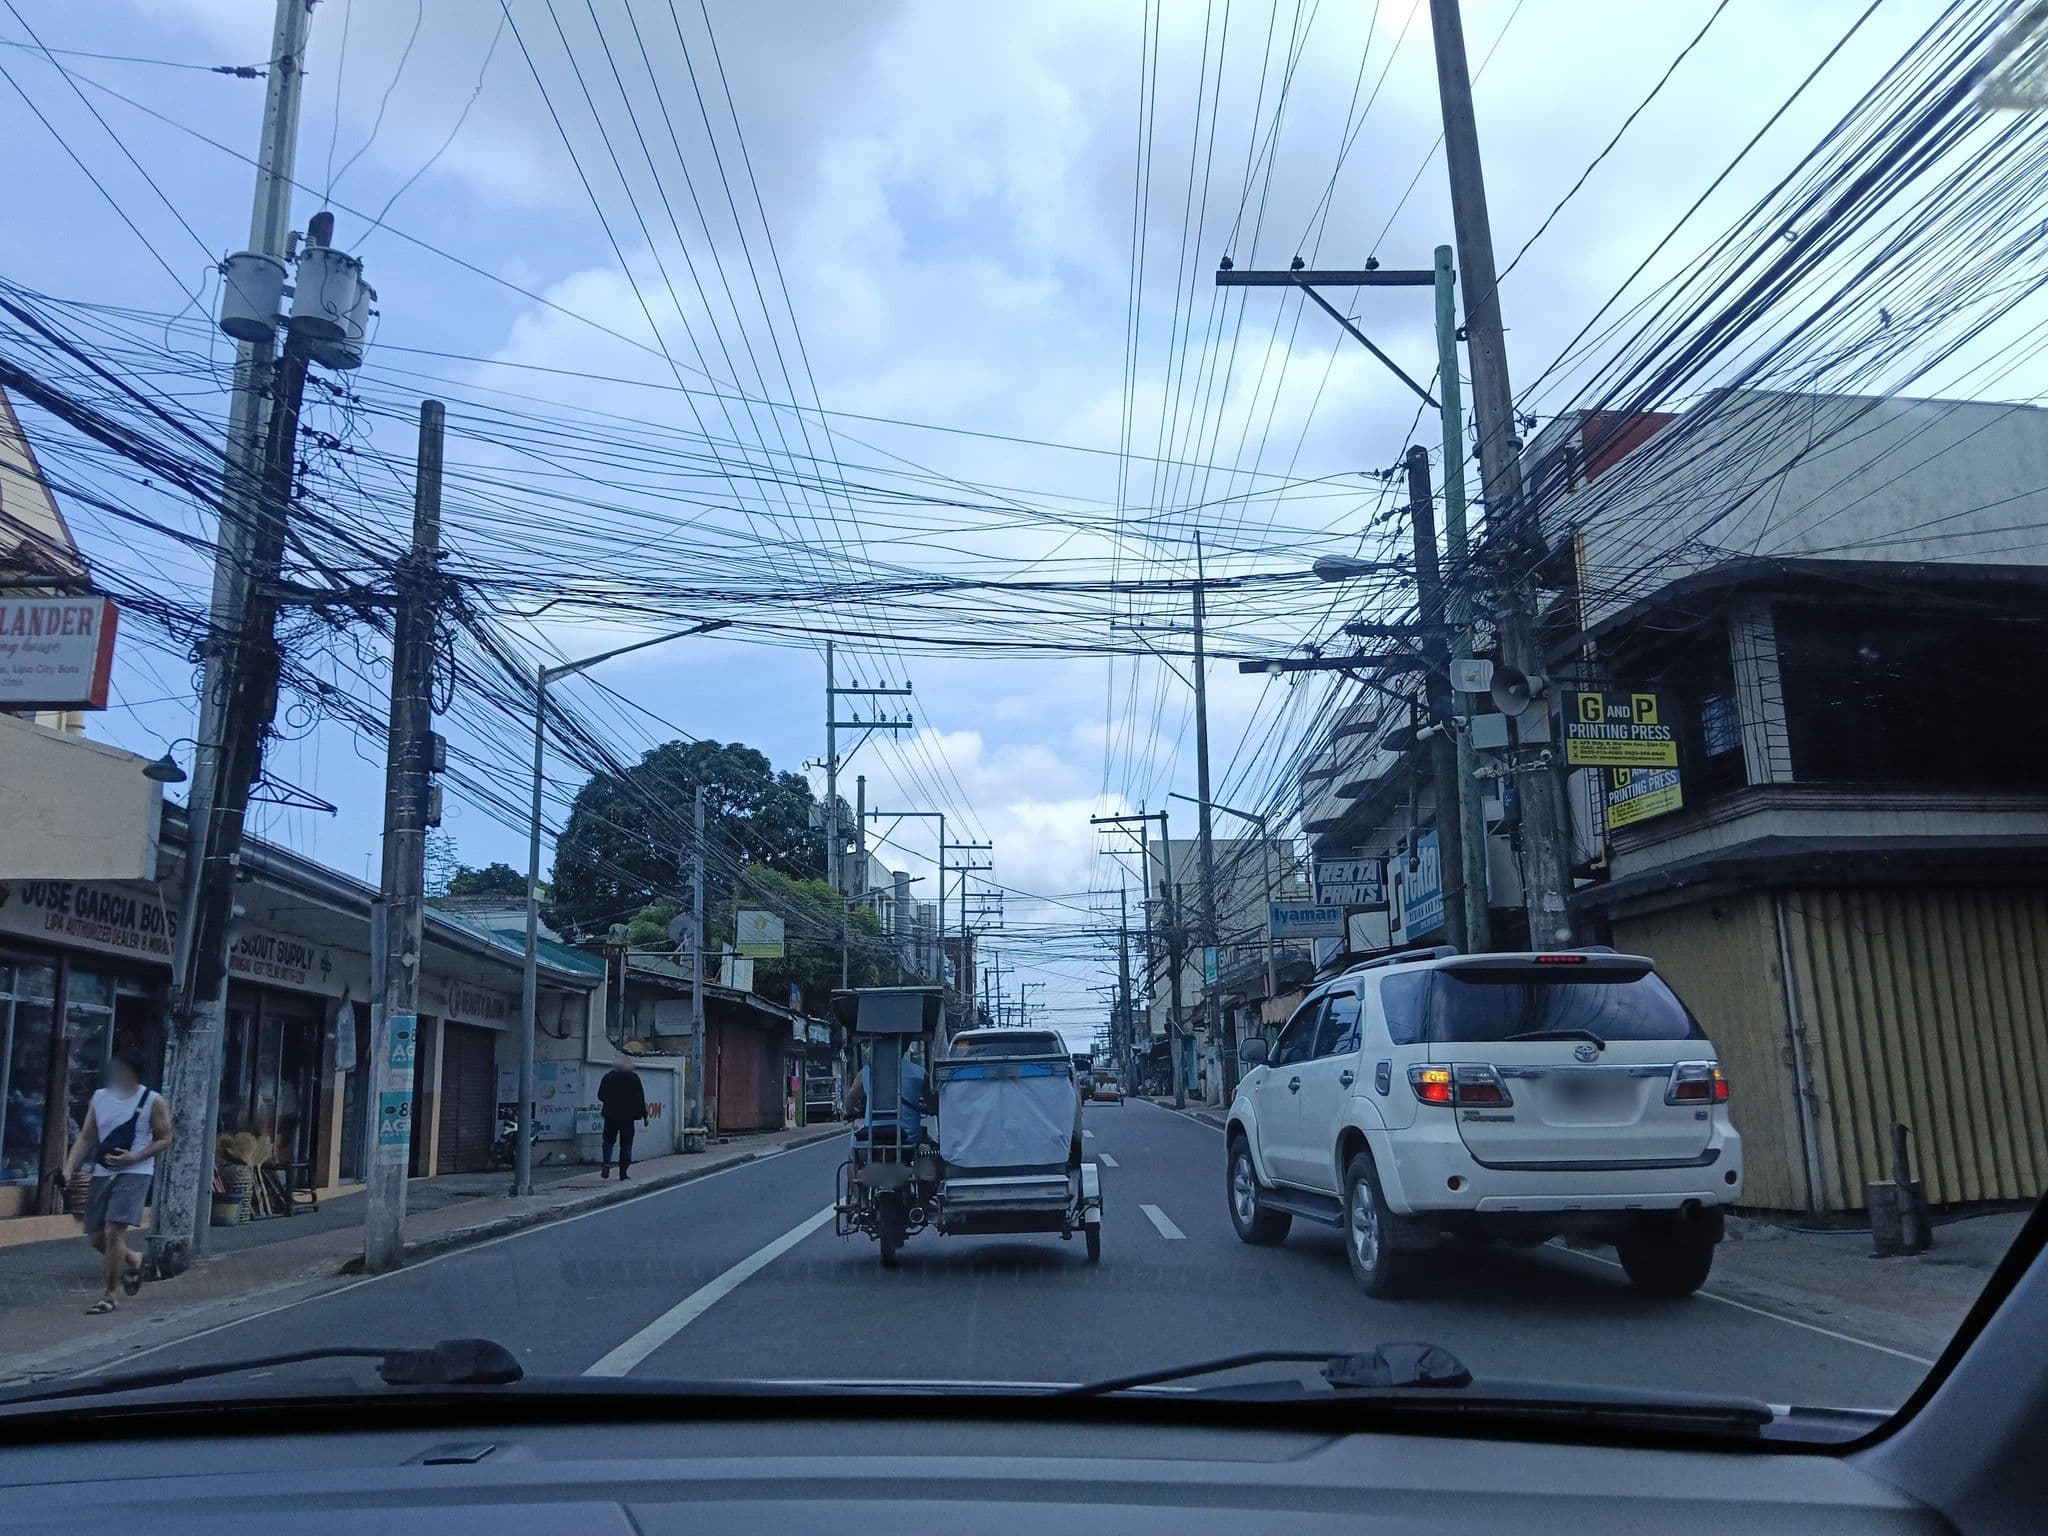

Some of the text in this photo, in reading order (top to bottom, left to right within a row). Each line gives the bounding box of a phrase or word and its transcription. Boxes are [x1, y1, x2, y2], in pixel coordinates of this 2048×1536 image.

[1582, 697, 1653, 722] G AND P
[1569, 723, 1671, 740] PRINTING PRESS
[1608, 779, 1647, 805] PRINTING
[1648, 769, 1677, 791] PRESS
[1318, 862, 1378, 883] REKTA
[1319, 883, 1378, 904] PRINTS
[21, 879, 178, 938] JOSE GARCIA BOYS
[240, 935, 276, 960] SCOUT
[277, 940, 315, 971] SUPPLY
